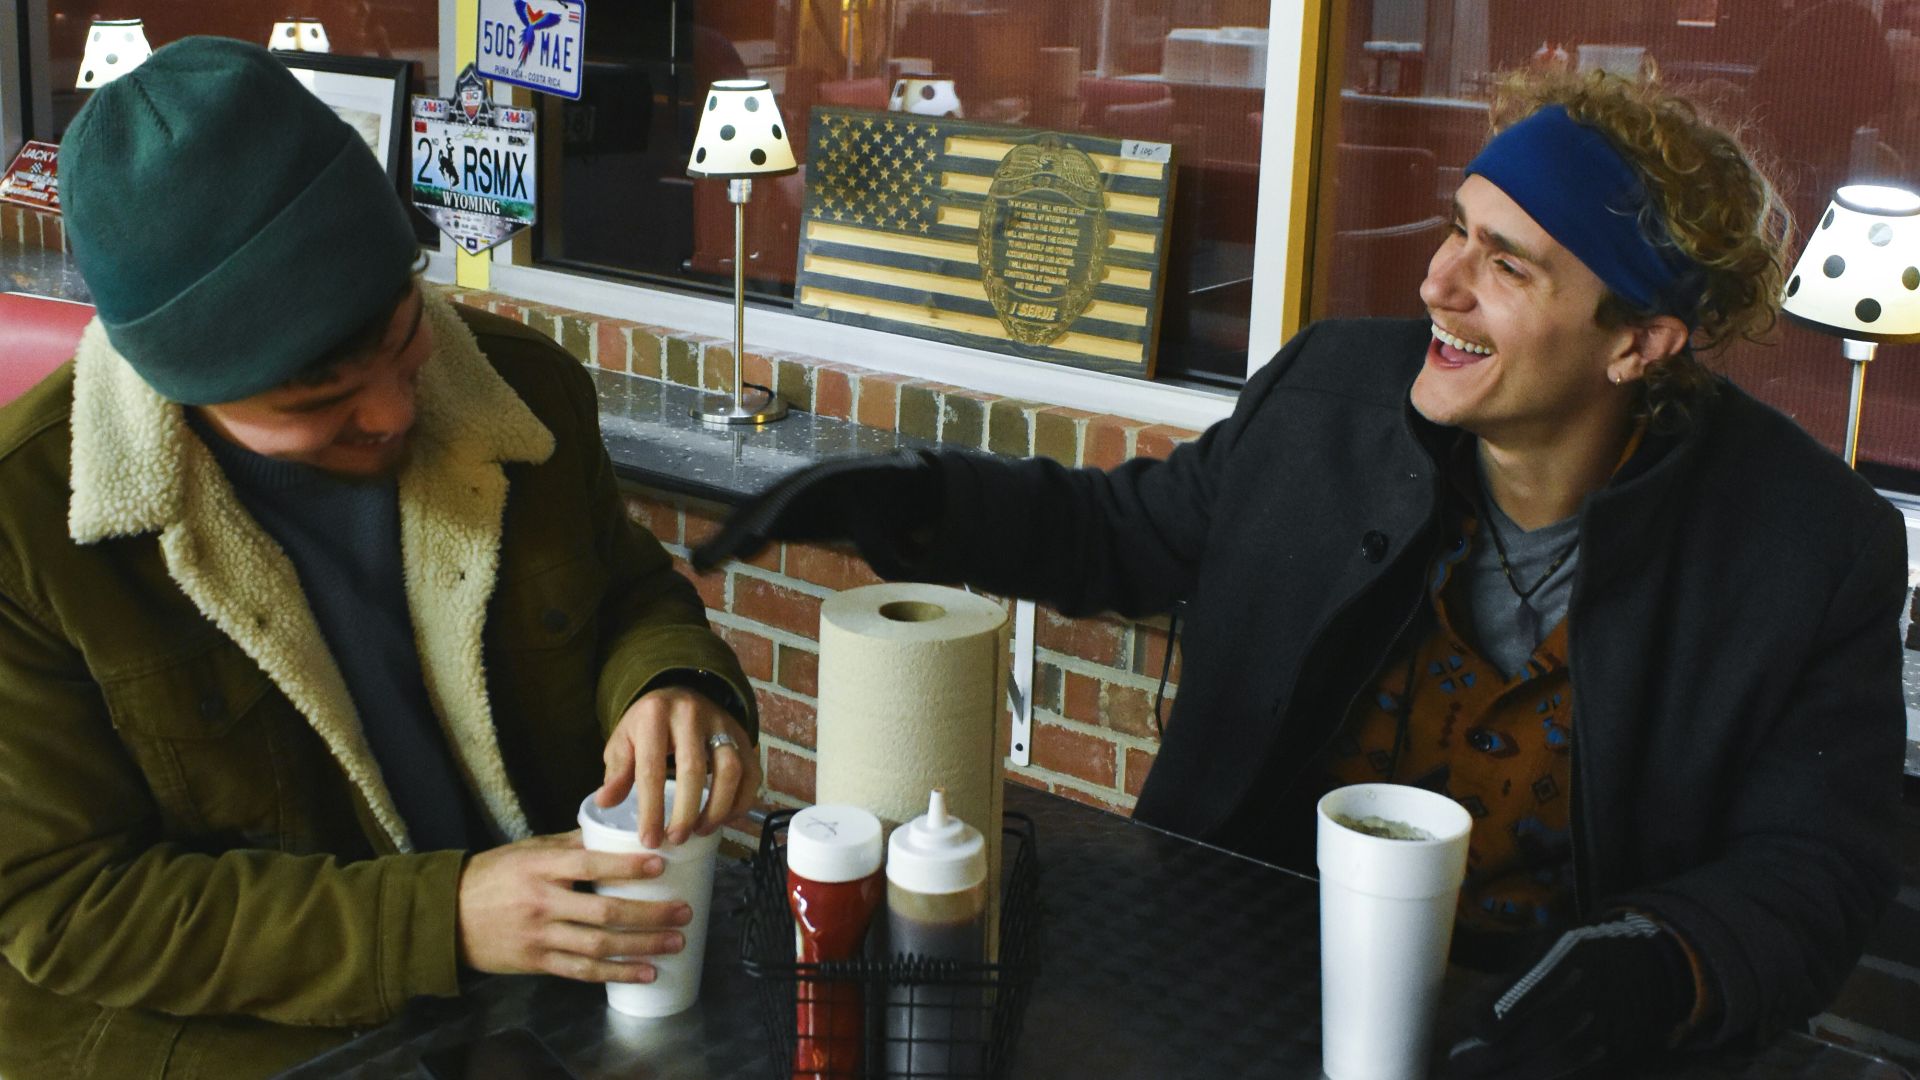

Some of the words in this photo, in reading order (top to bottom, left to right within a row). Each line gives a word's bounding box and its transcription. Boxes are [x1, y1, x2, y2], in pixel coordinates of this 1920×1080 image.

[484, 20, 516, 60] 506
[540, 31, 574, 73] MAE
[494, 65, 509, 75] PURA
[528, 72, 546, 83] COSTA
[547, 76, 560, 86] RICA
[22, 148, 58, 163] JACKY
[418, 137, 433, 184] 2
[464, 145, 528, 200] RSMX
[442, 191, 501, 215] WYOMING
[1018, 303, 1058, 321] SERVE
